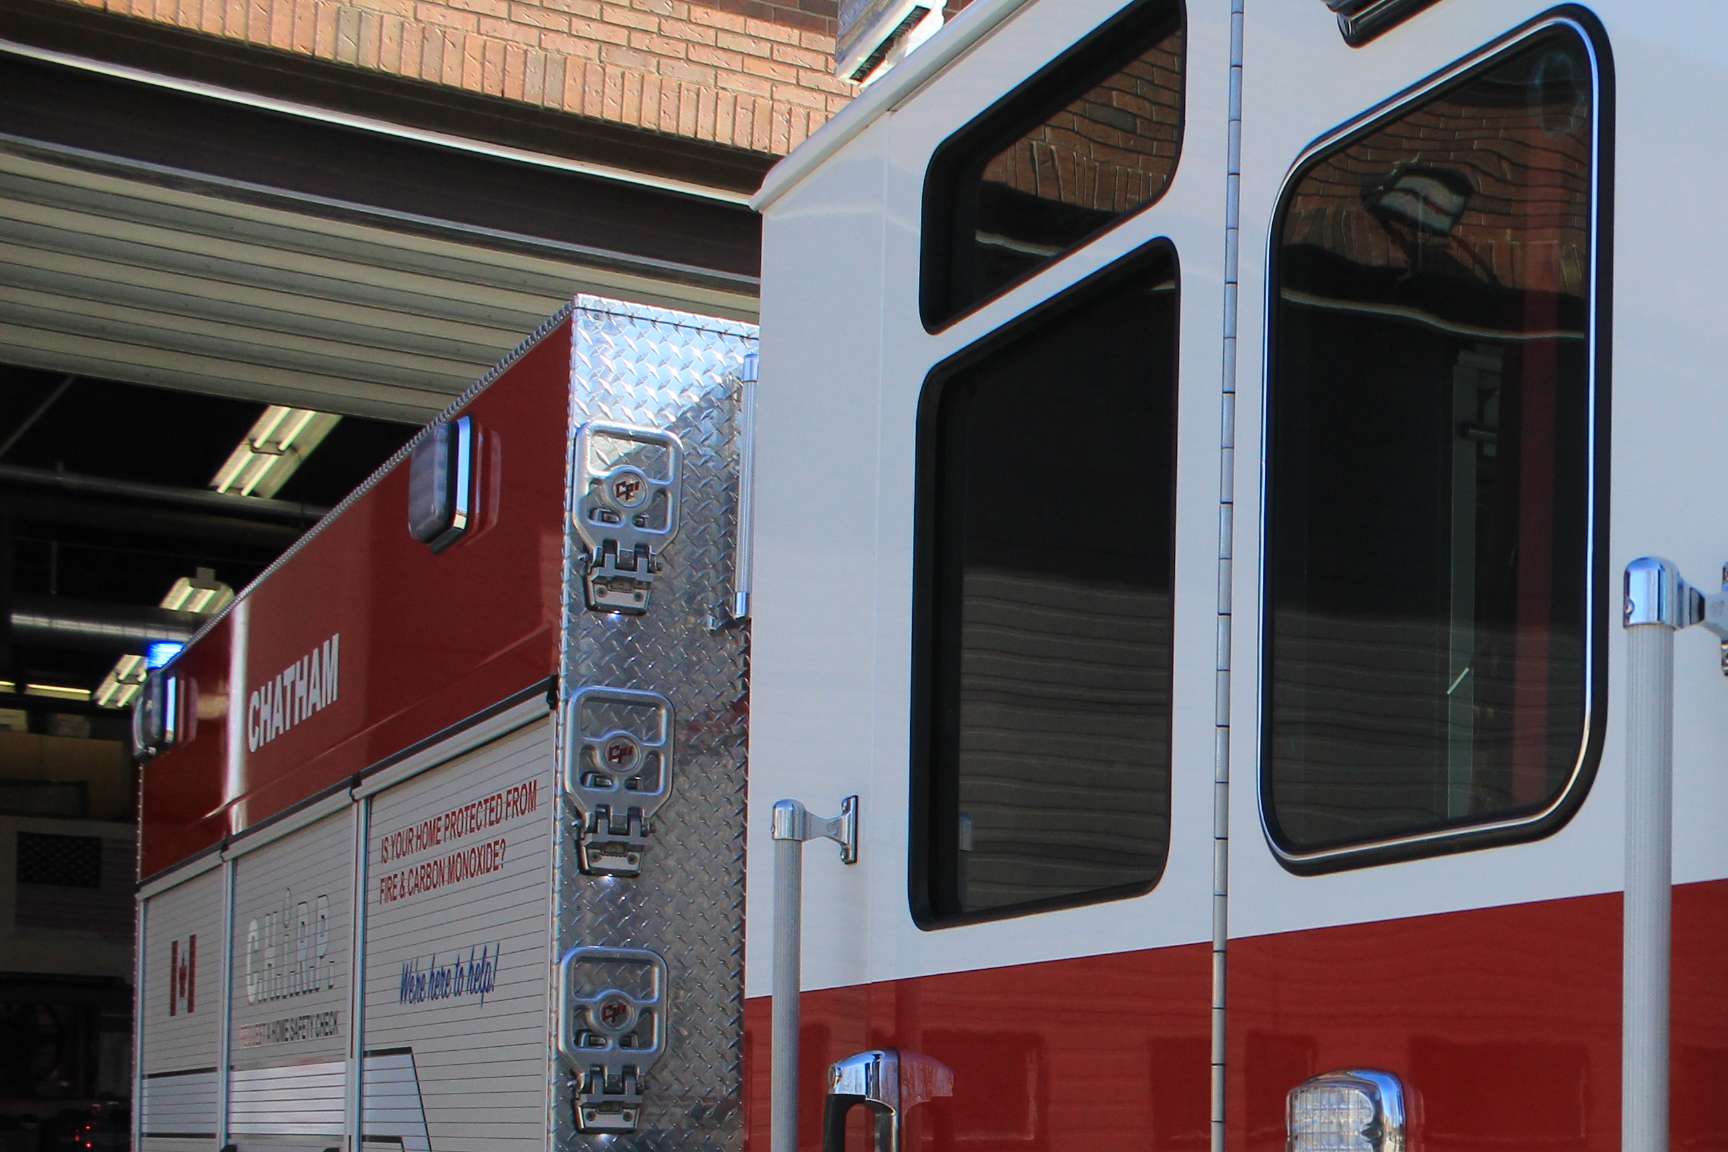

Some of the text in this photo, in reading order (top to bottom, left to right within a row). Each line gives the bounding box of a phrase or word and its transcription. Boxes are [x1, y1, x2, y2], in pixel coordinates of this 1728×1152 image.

[248, 632, 340, 753] CHATHAM
[380, 779, 538, 864] IS YOUR HOME PROTECTED FROM
[379, 838, 507, 904] FIRE & CARBON MONOXIDE?
[428, 952, 452, 1001] here
[454, 953, 464, 998] to
[467, 942, 500, 1009] help!
[289, 1014, 313, 1042] SAFETY
[315, 1010, 338, 1038] CHECK
